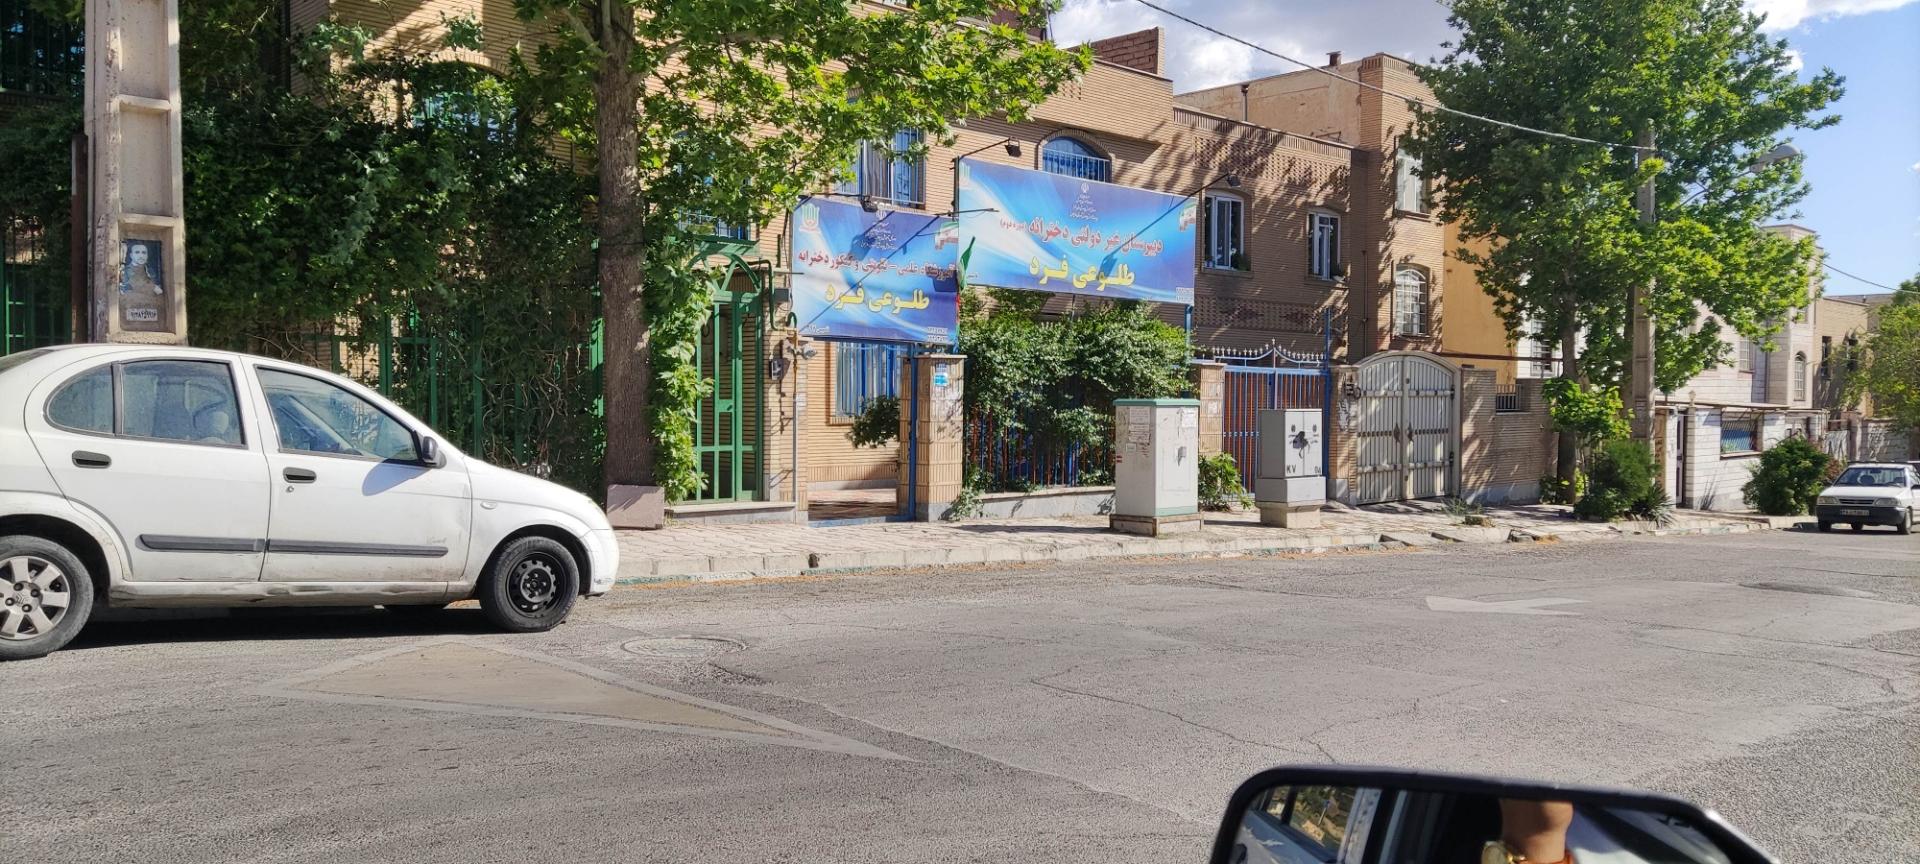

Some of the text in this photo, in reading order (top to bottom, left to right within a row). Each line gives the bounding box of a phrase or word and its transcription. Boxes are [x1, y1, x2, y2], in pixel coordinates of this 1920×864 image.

[1028, 217, 1069, 243] دخترانه
[1071, 224, 1102, 248] دولتی
[1104, 233, 1121, 250] غیر
[1121, 232, 1164, 257] دبیرستان
[799, 249, 829, 267] دخترانه
[1029, 254, 1069, 285] فرد
[825, 282, 865, 309] فرد
